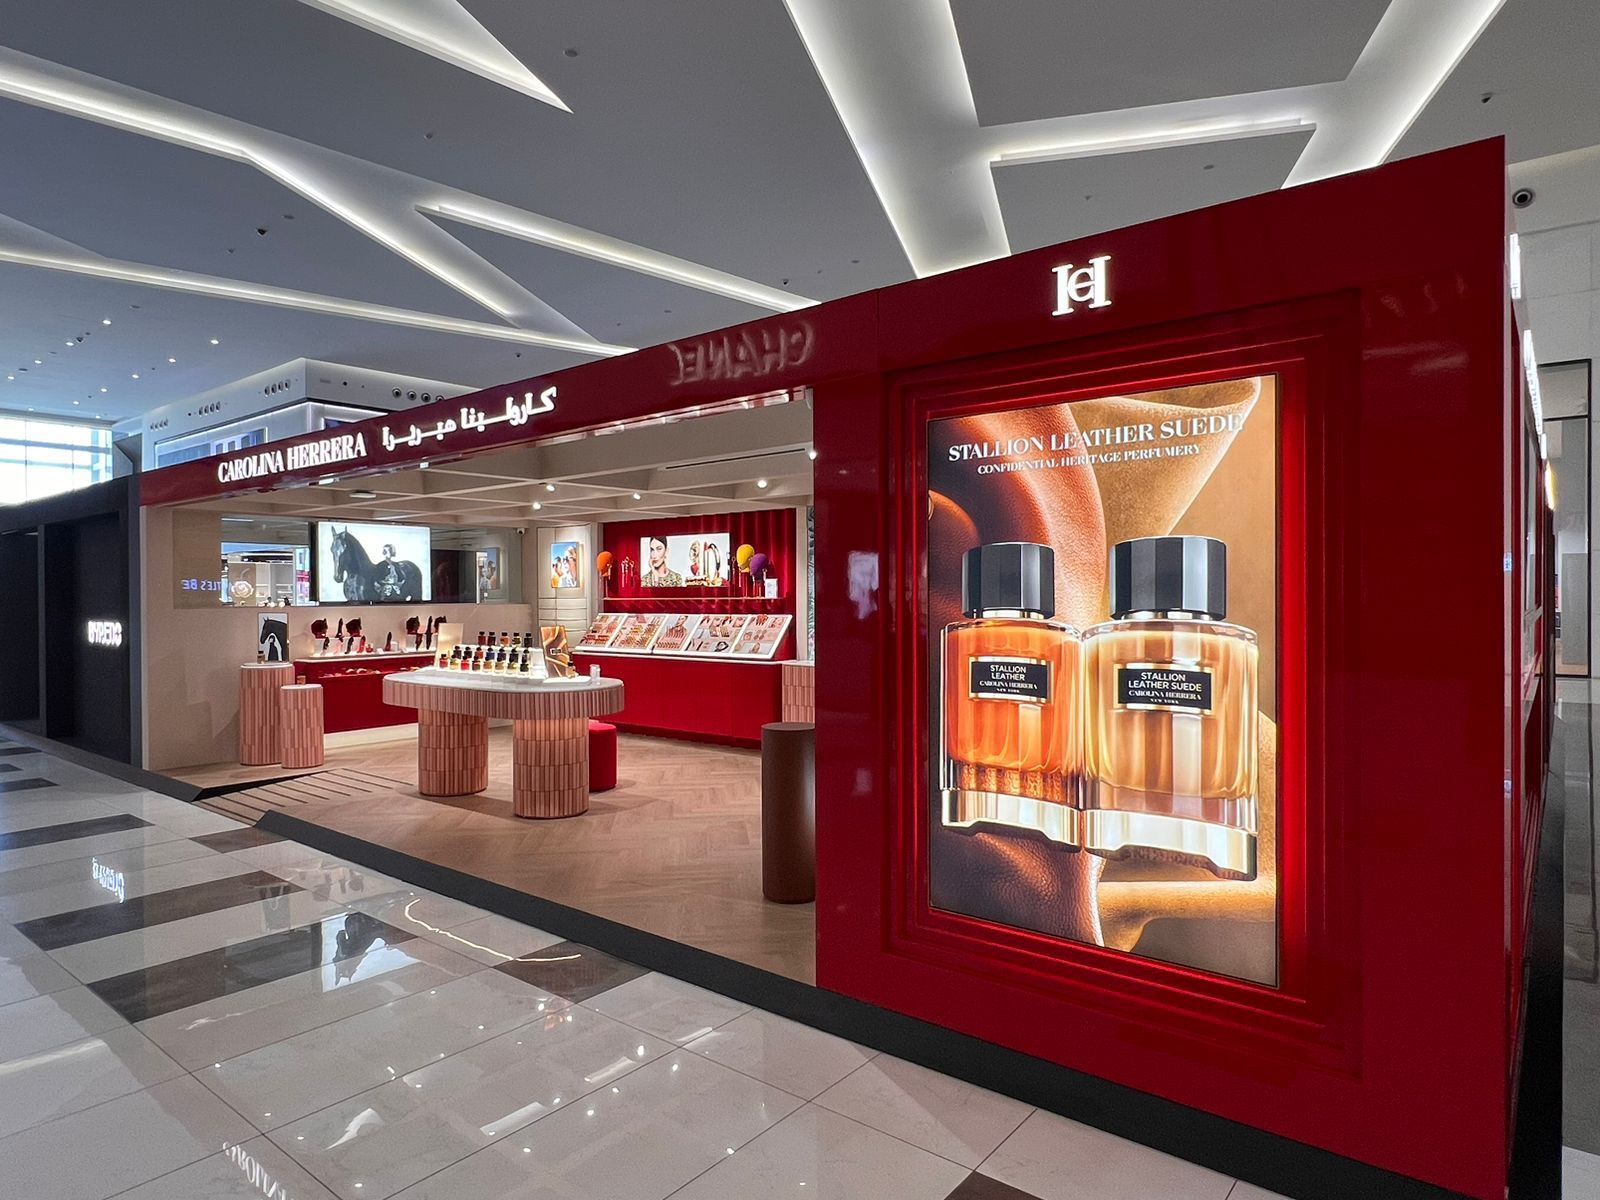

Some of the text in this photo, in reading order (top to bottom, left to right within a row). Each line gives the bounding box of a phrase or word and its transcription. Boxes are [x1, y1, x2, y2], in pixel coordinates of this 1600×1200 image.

[382, 386, 557, 451] كارولينا هيريرا
[948, 413, 1244, 462] STALLION LEATHER SUEDE
[217, 432, 367, 483] CAROLINA HERRERA
[977, 444, 1201, 475] CONFIDENTIAL HERITAGE PERFUMERY
[990, 664, 1026, 673] STALLION
[991, 673, 1025, 681] LEATHER
[1141, 672, 1186, 681] STALLION
[1128, 680, 1202, 692] LEATHER SUEDE
[1165, 691, 1202, 700] HERRERA
